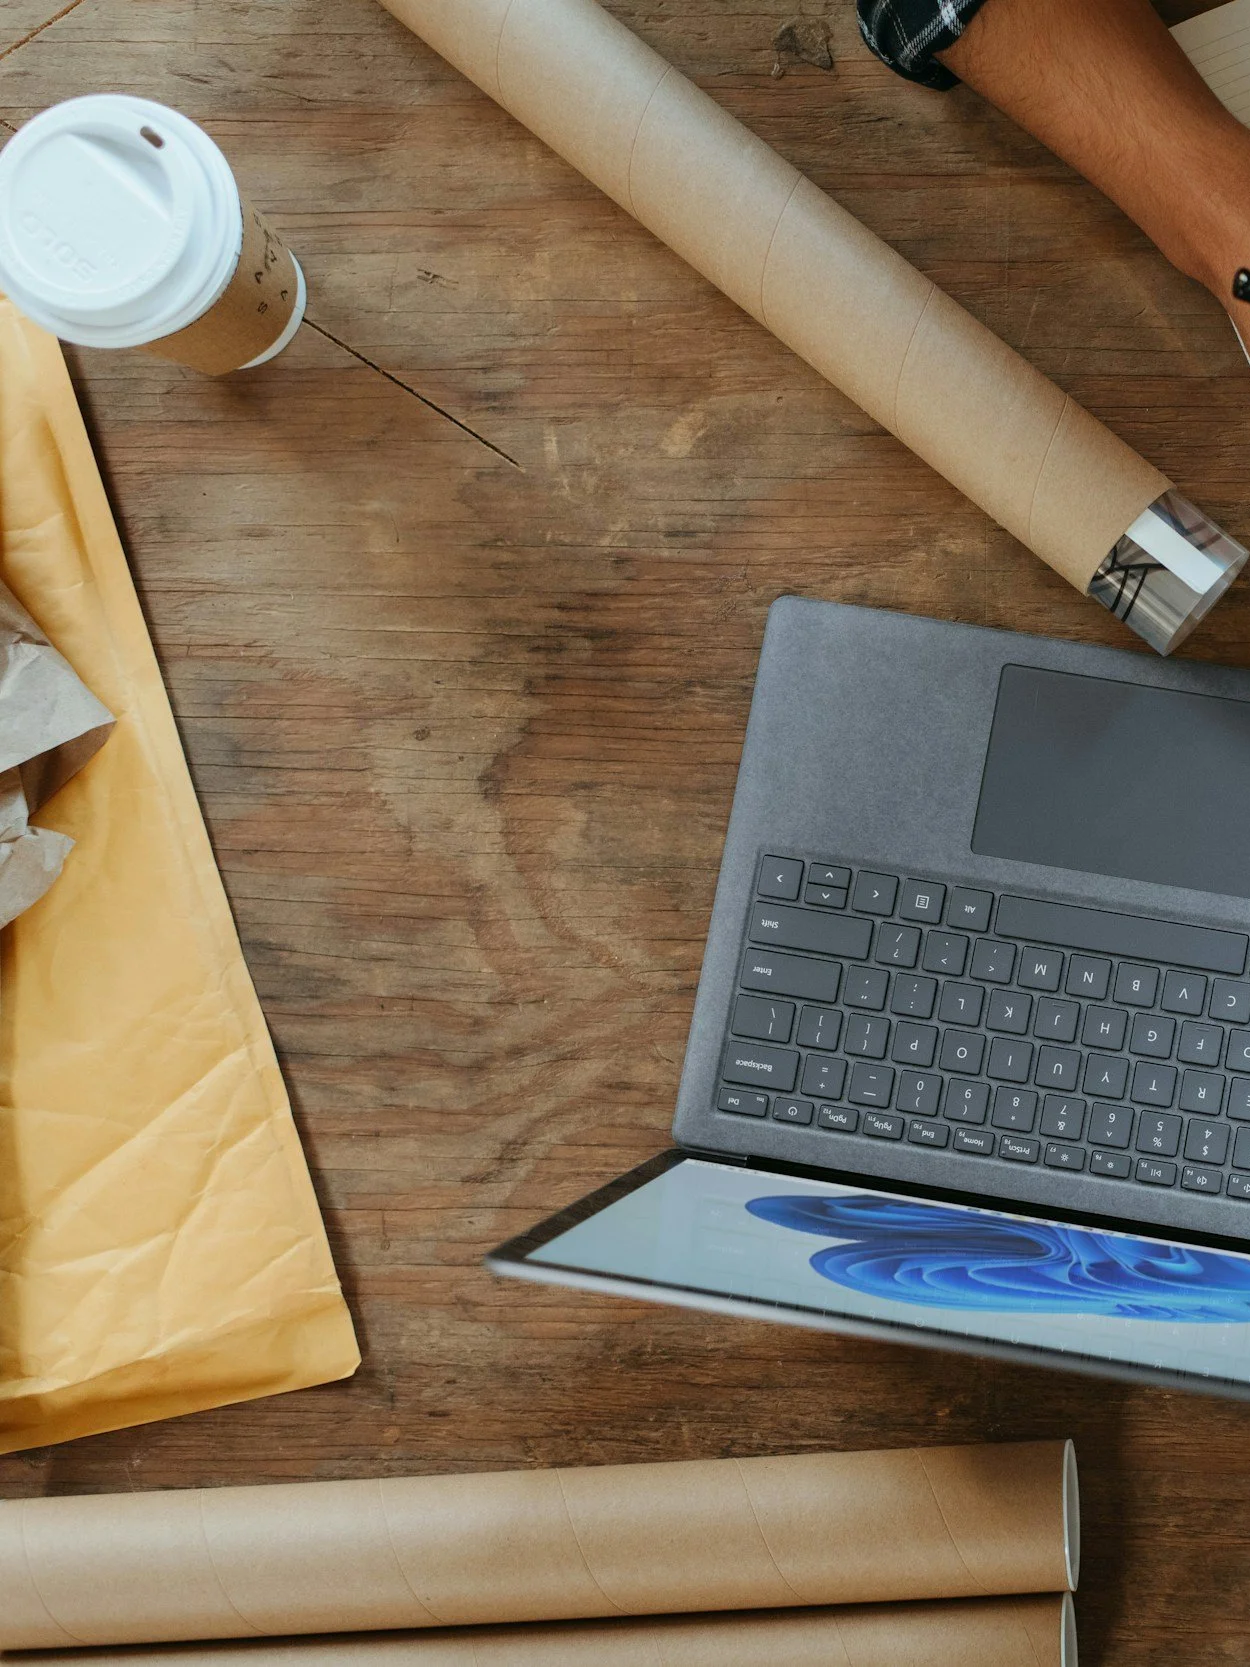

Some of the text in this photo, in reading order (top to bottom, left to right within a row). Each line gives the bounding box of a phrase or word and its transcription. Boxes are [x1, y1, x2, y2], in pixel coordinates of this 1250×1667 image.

[964, 905, 976, 914] Alt
[761, 918, 779, 929] Shift
[895, 932, 903, 943] /
[893, 948, 899, 958] ?
[752, 966, 773, 976] Enter
[1034, 963, 1047, 976] M
[1083, 971, 1094, 984] N
[1132, 979, 1141, 992] B
[1178, 987, 1188, 1000] V
[958, 998, 965, 1010] L
[1226, 995, 1237, 1007] C
[1004, 1006, 1014, 1018] K
[1054, 1014, 1061, 1026] J
[1100, 1022, 1111, 1034] H
[1147, 1030, 1158, 1042] G
[909, 1039, 919, 1051] P
[1196, 1038, 1204, 1050] F
[956, 1047, 968, 1059] O
[735, 1059, 773, 1073] Backspace
[1052, 1063, 1063, 1075] U
[1101, 1071, 1110, 1083] Y
[916, 1080, 925, 1091] 0
[1149, 1079, 1157, 1091] T
[964, 1088, 972, 1099] 9
[1197, 1087, 1207, 1099] R
[727, 1097, 740, 1106] Del
[1012, 1096, 1020, 1107] 8
[1060, 1104, 1067, 1115] 7
[828, 1113, 848, 1124] PgDn
[1108, 1112, 1116, 1123] 6
[873, 1120, 893, 1131] PgUp
[1057, 1120, 1066, 1131] &
[1156, 1121, 1164, 1132] 5
[921, 1130, 936, 1139] End
[1204, 1129, 1213, 1139] 4
[963, 1137, 984, 1147] Home
[1152, 1136, 1162, 1148] %
[1008, 1145, 1031, 1155] PrtScn
[1202, 1145, 1209, 1156] $
